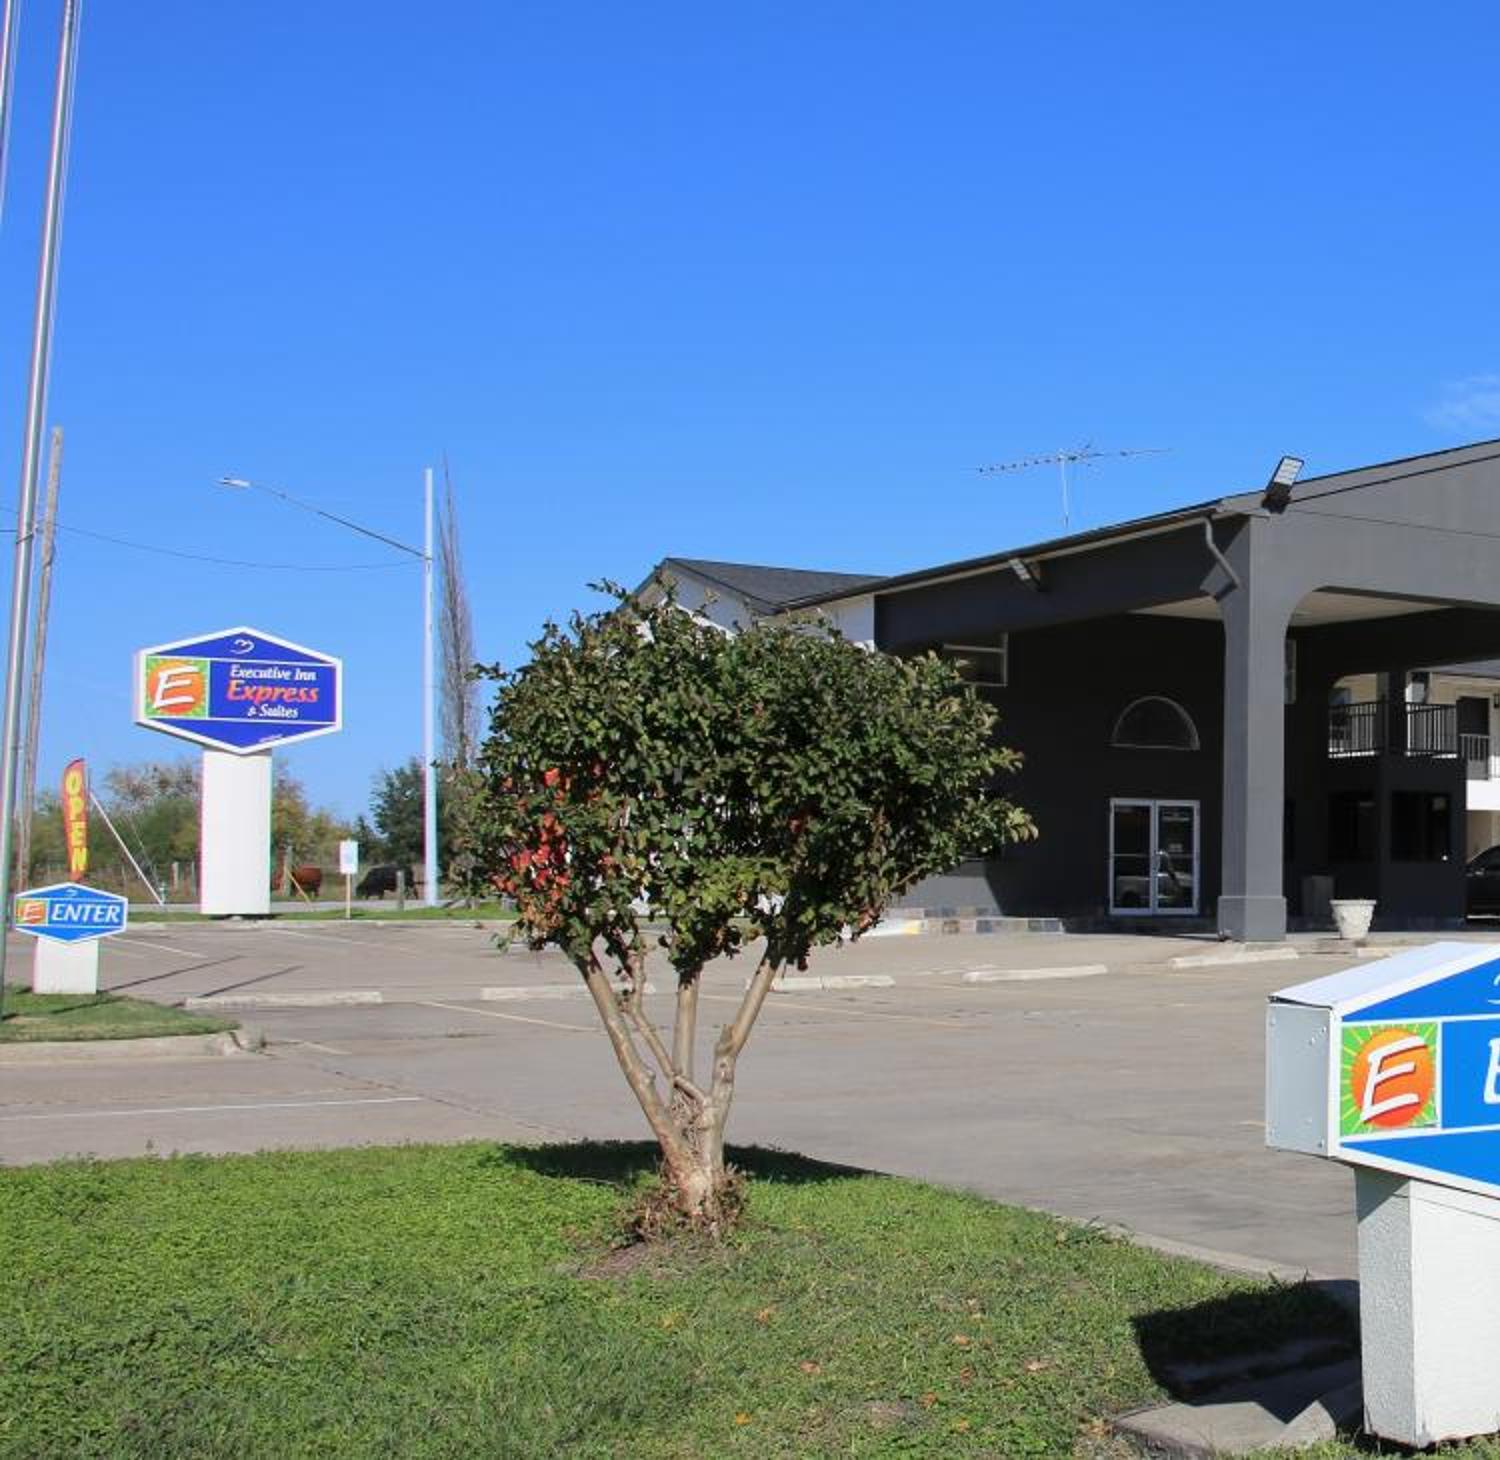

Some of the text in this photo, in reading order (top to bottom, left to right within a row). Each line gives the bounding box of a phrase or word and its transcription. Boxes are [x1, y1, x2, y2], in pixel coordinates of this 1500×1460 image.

[230, 663, 317, 681] Executive Inn
[154, 665, 199, 709] E
[226, 679, 319, 704] Express
[259, 703, 299, 719] Suites
[65, 770, 88, 873] OPEN
[23, 903, 120, 923] E ENTER
[1361, 1036, 1427, 1122] E
